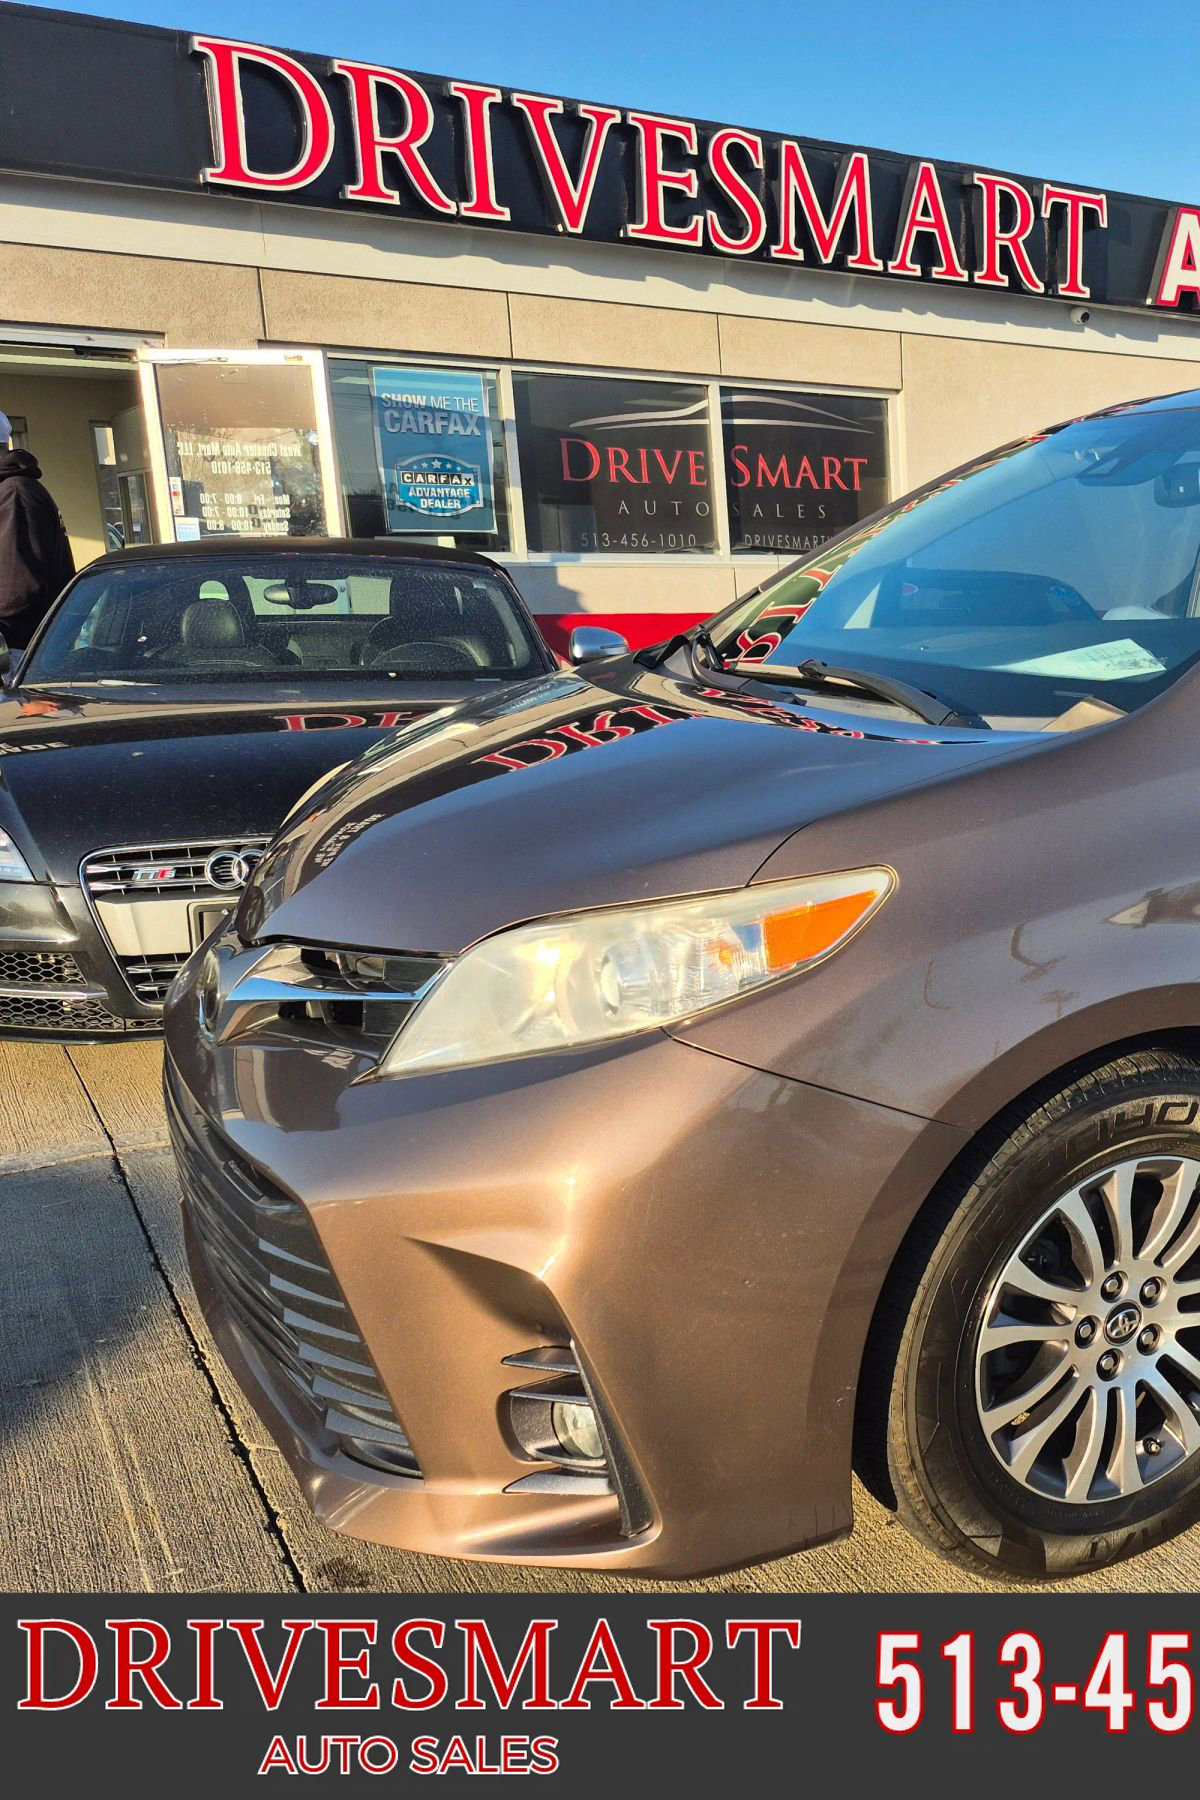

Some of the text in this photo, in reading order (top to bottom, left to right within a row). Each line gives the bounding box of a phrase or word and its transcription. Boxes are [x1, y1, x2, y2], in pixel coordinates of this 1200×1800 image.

[192, 36, 1108, 298] DRIVESMART
[381, 392, 478, 412] SHOW ME THE
[384, 409, 481, 436] CARFAX
[560, 438, 868, 491] DRIVE SMART
[402, 472, 474, 486] CARFAX
[408, 487, 471, 499] ADVANTAGE
[420, 498, 461, 509] DEALER
[618, 500, 827, 519] AUTO SALES
[581, 532, 696, 548] 513-456-1010
